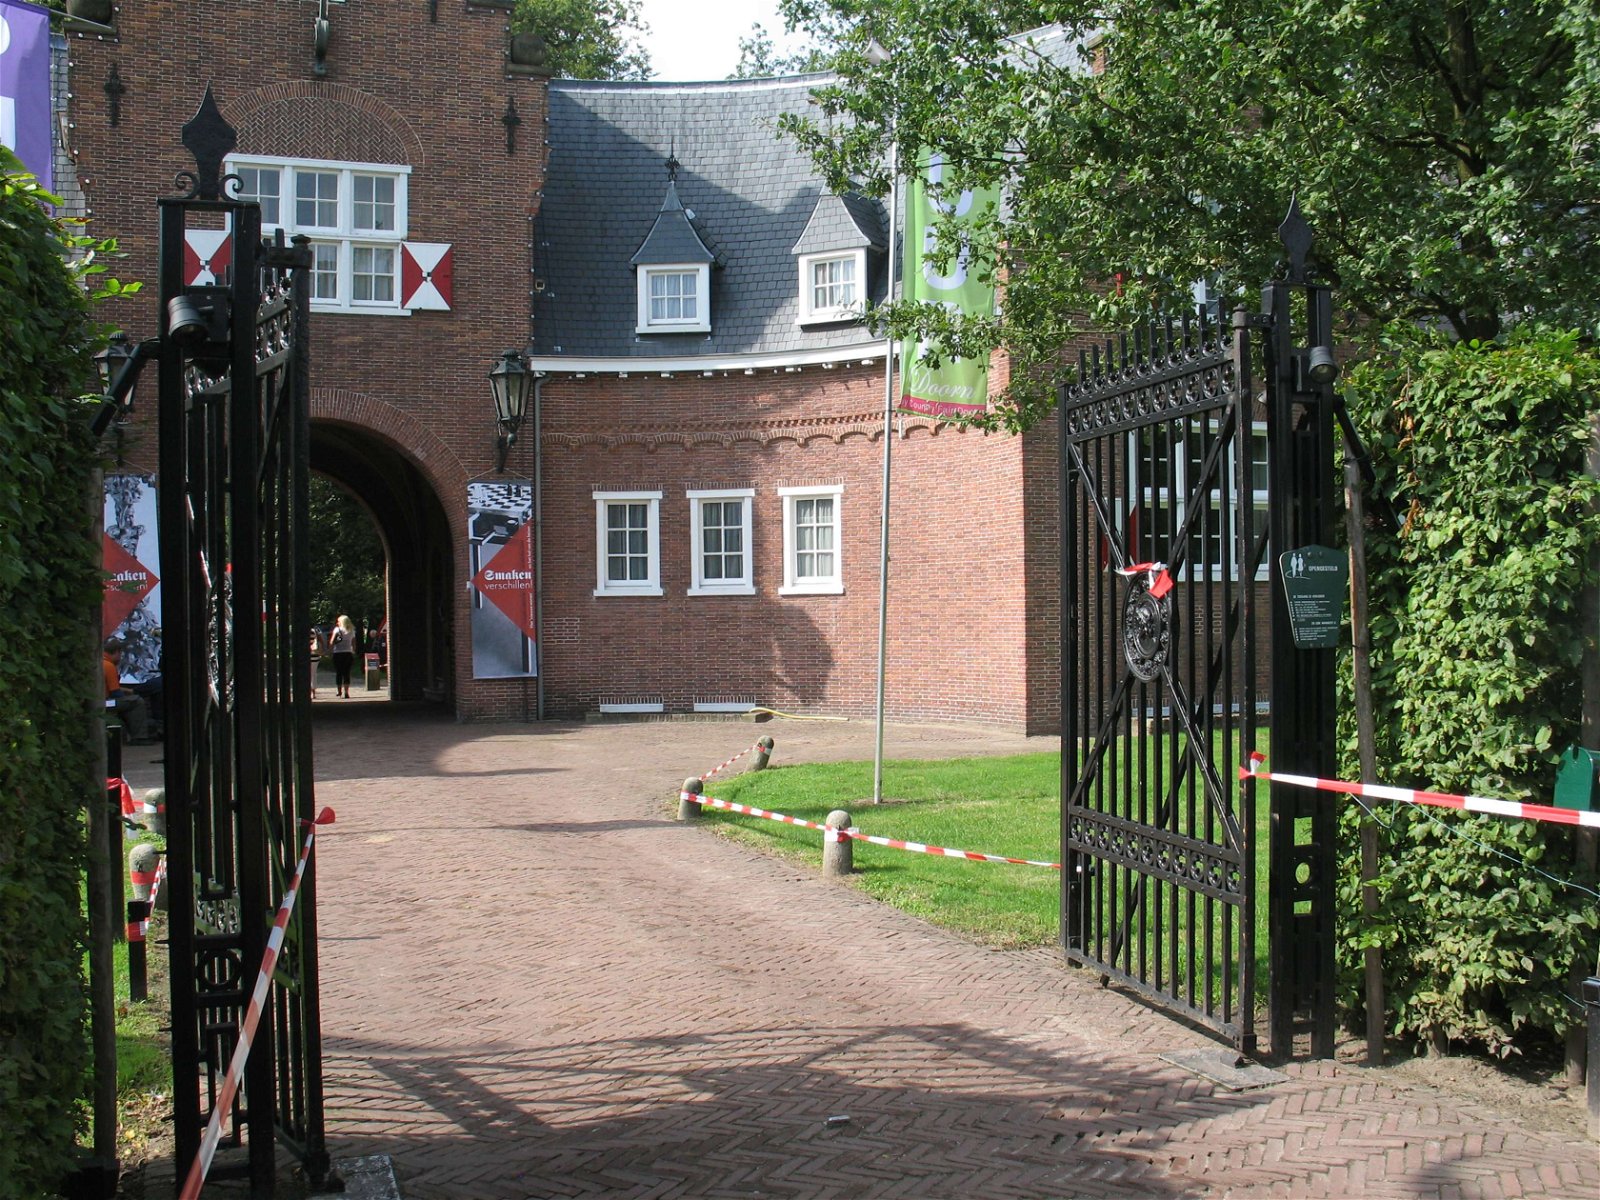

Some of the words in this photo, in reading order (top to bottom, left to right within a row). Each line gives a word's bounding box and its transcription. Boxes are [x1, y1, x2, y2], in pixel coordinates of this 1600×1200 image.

[909, 366, 974, 399] Doorn
[104, 569, 147, 582] aken
[484, 569, 532, 581] Smaken
[484, 579, 534, 590] verschillen!
